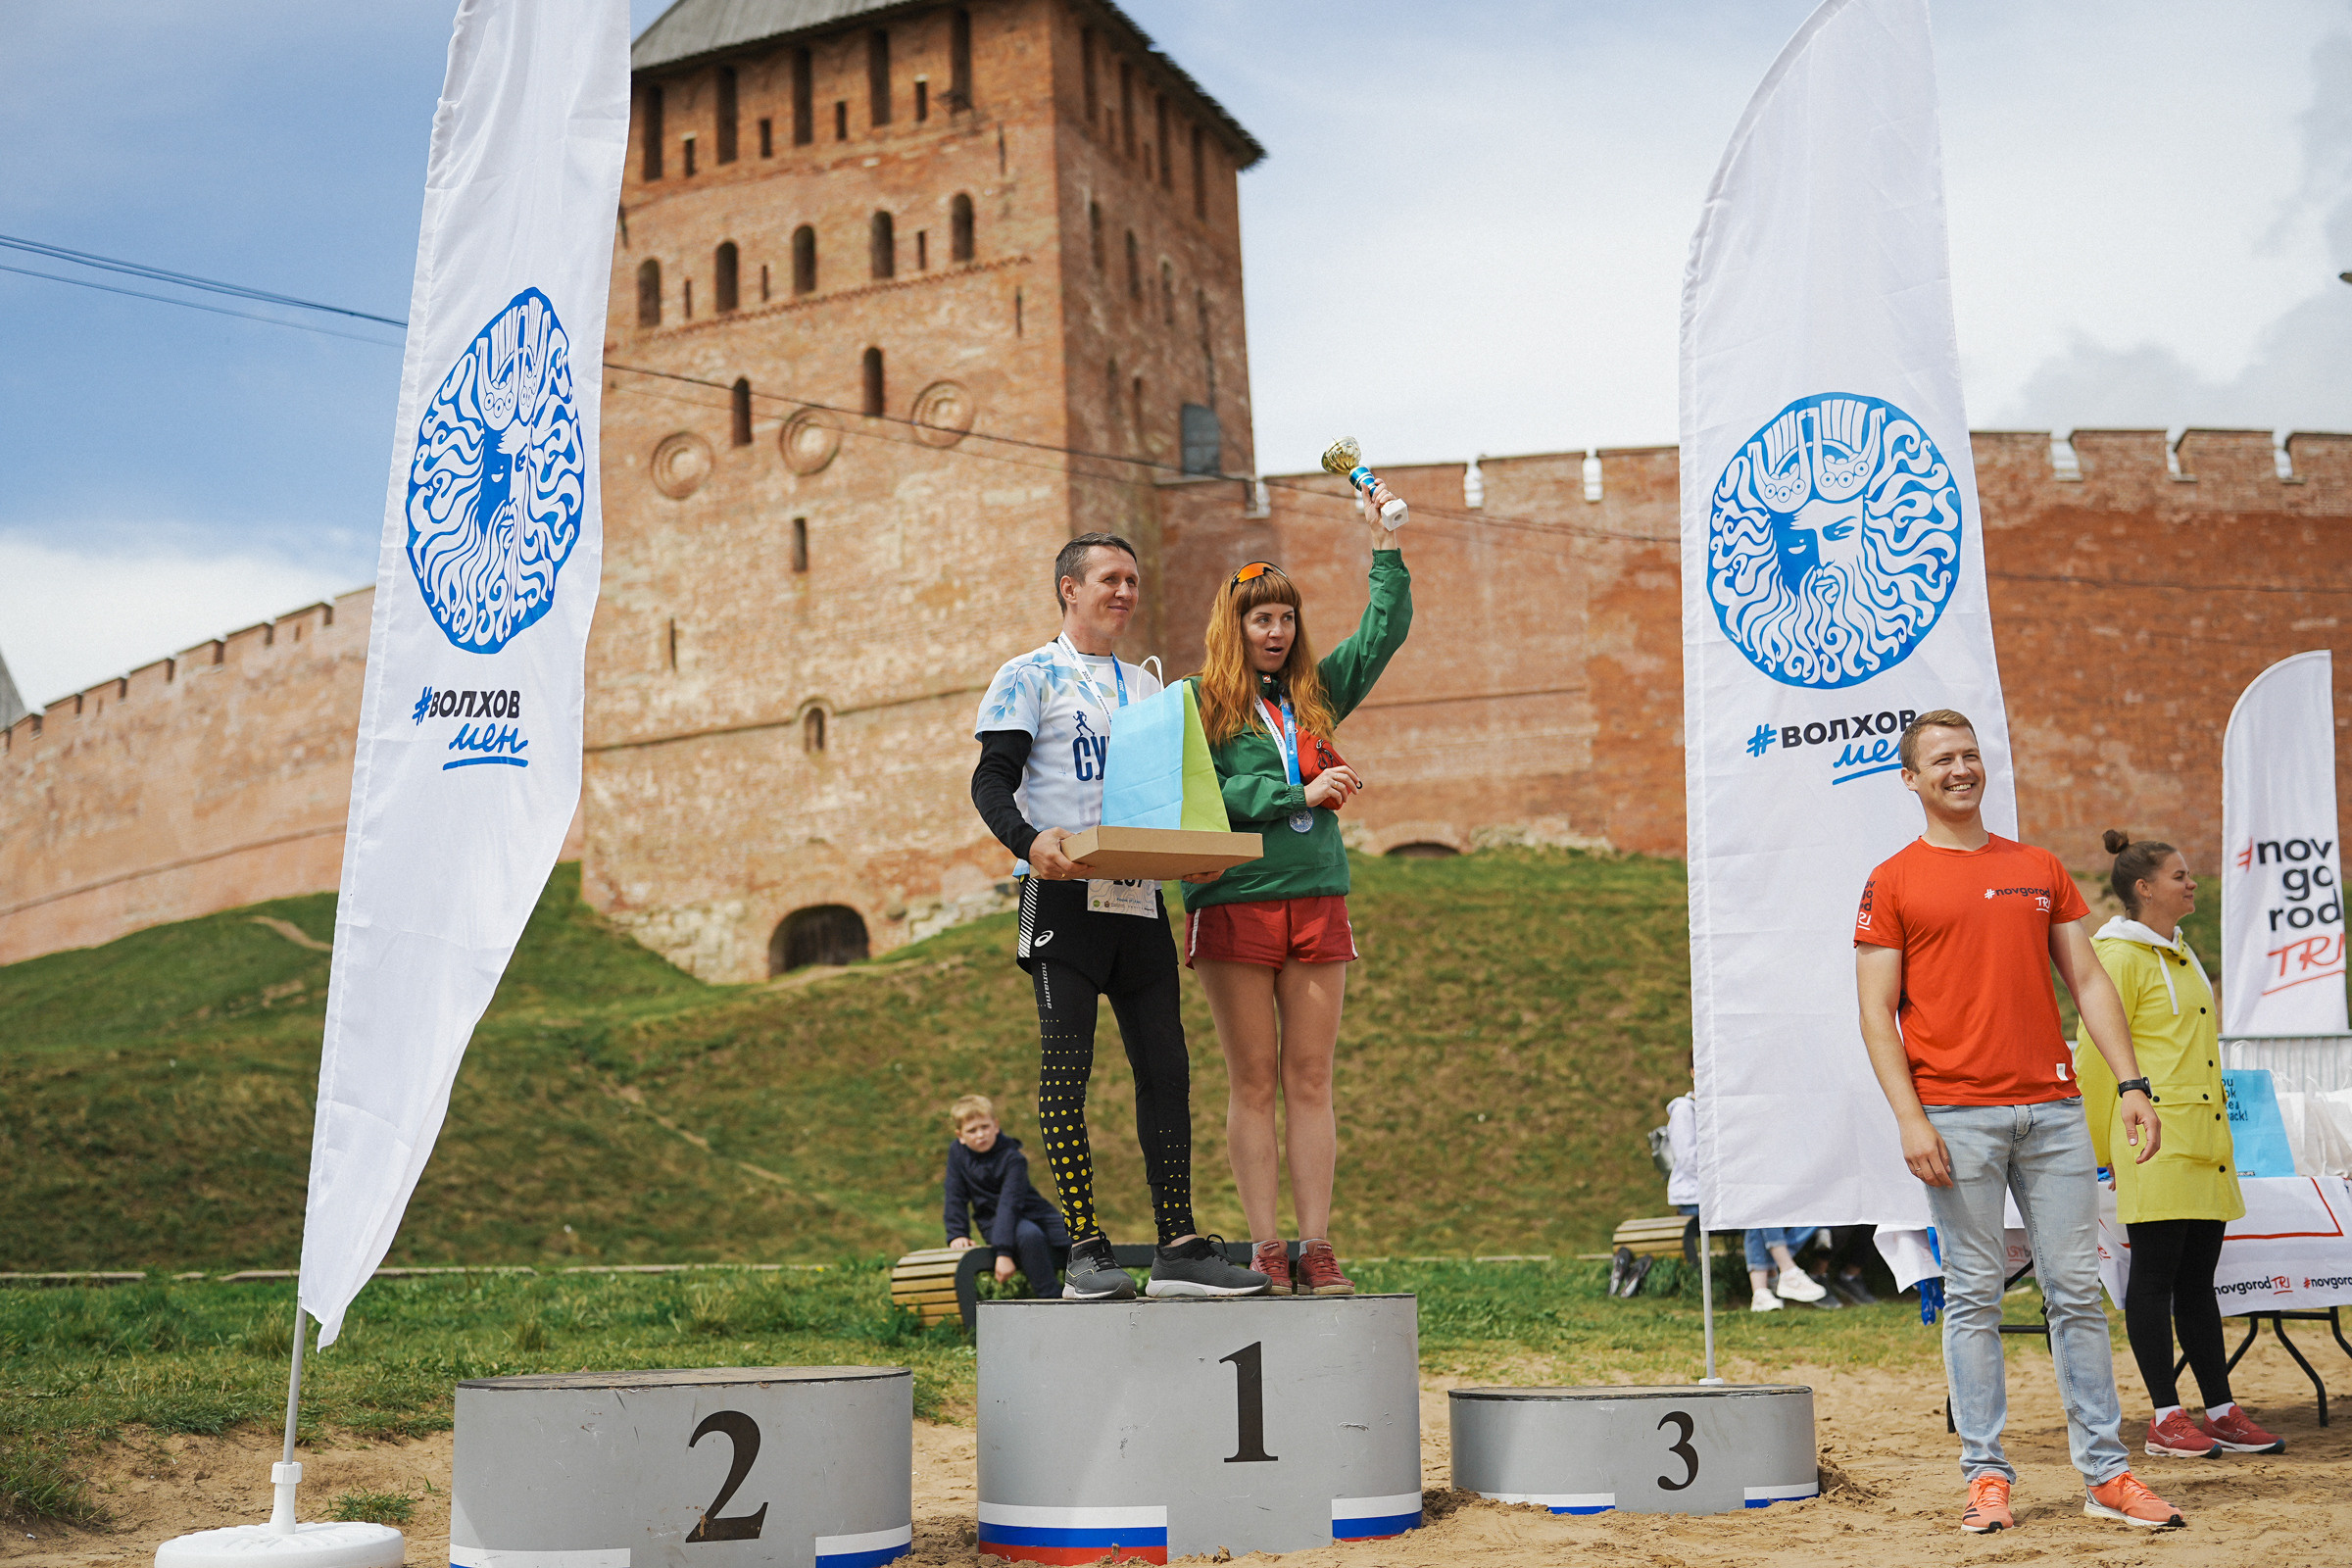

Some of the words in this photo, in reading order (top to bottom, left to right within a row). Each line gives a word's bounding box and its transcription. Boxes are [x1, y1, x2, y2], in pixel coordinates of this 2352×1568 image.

[412, 686, 520, 726] #ВОЛХОВ
[1072, 735, 1110, 781] СУ
[1833, 738, 1902, 768] ме
[1984, 887, 2050, 900] #novgorod
[2269, 888, 2342, 932] rod
[1041, 962, 1053, 1009] noname
[1218, 1341, 1279, 1463] 1
[1657, 1411, 1699, 1491] 3
[685, 1410, 768, 1543] 2
